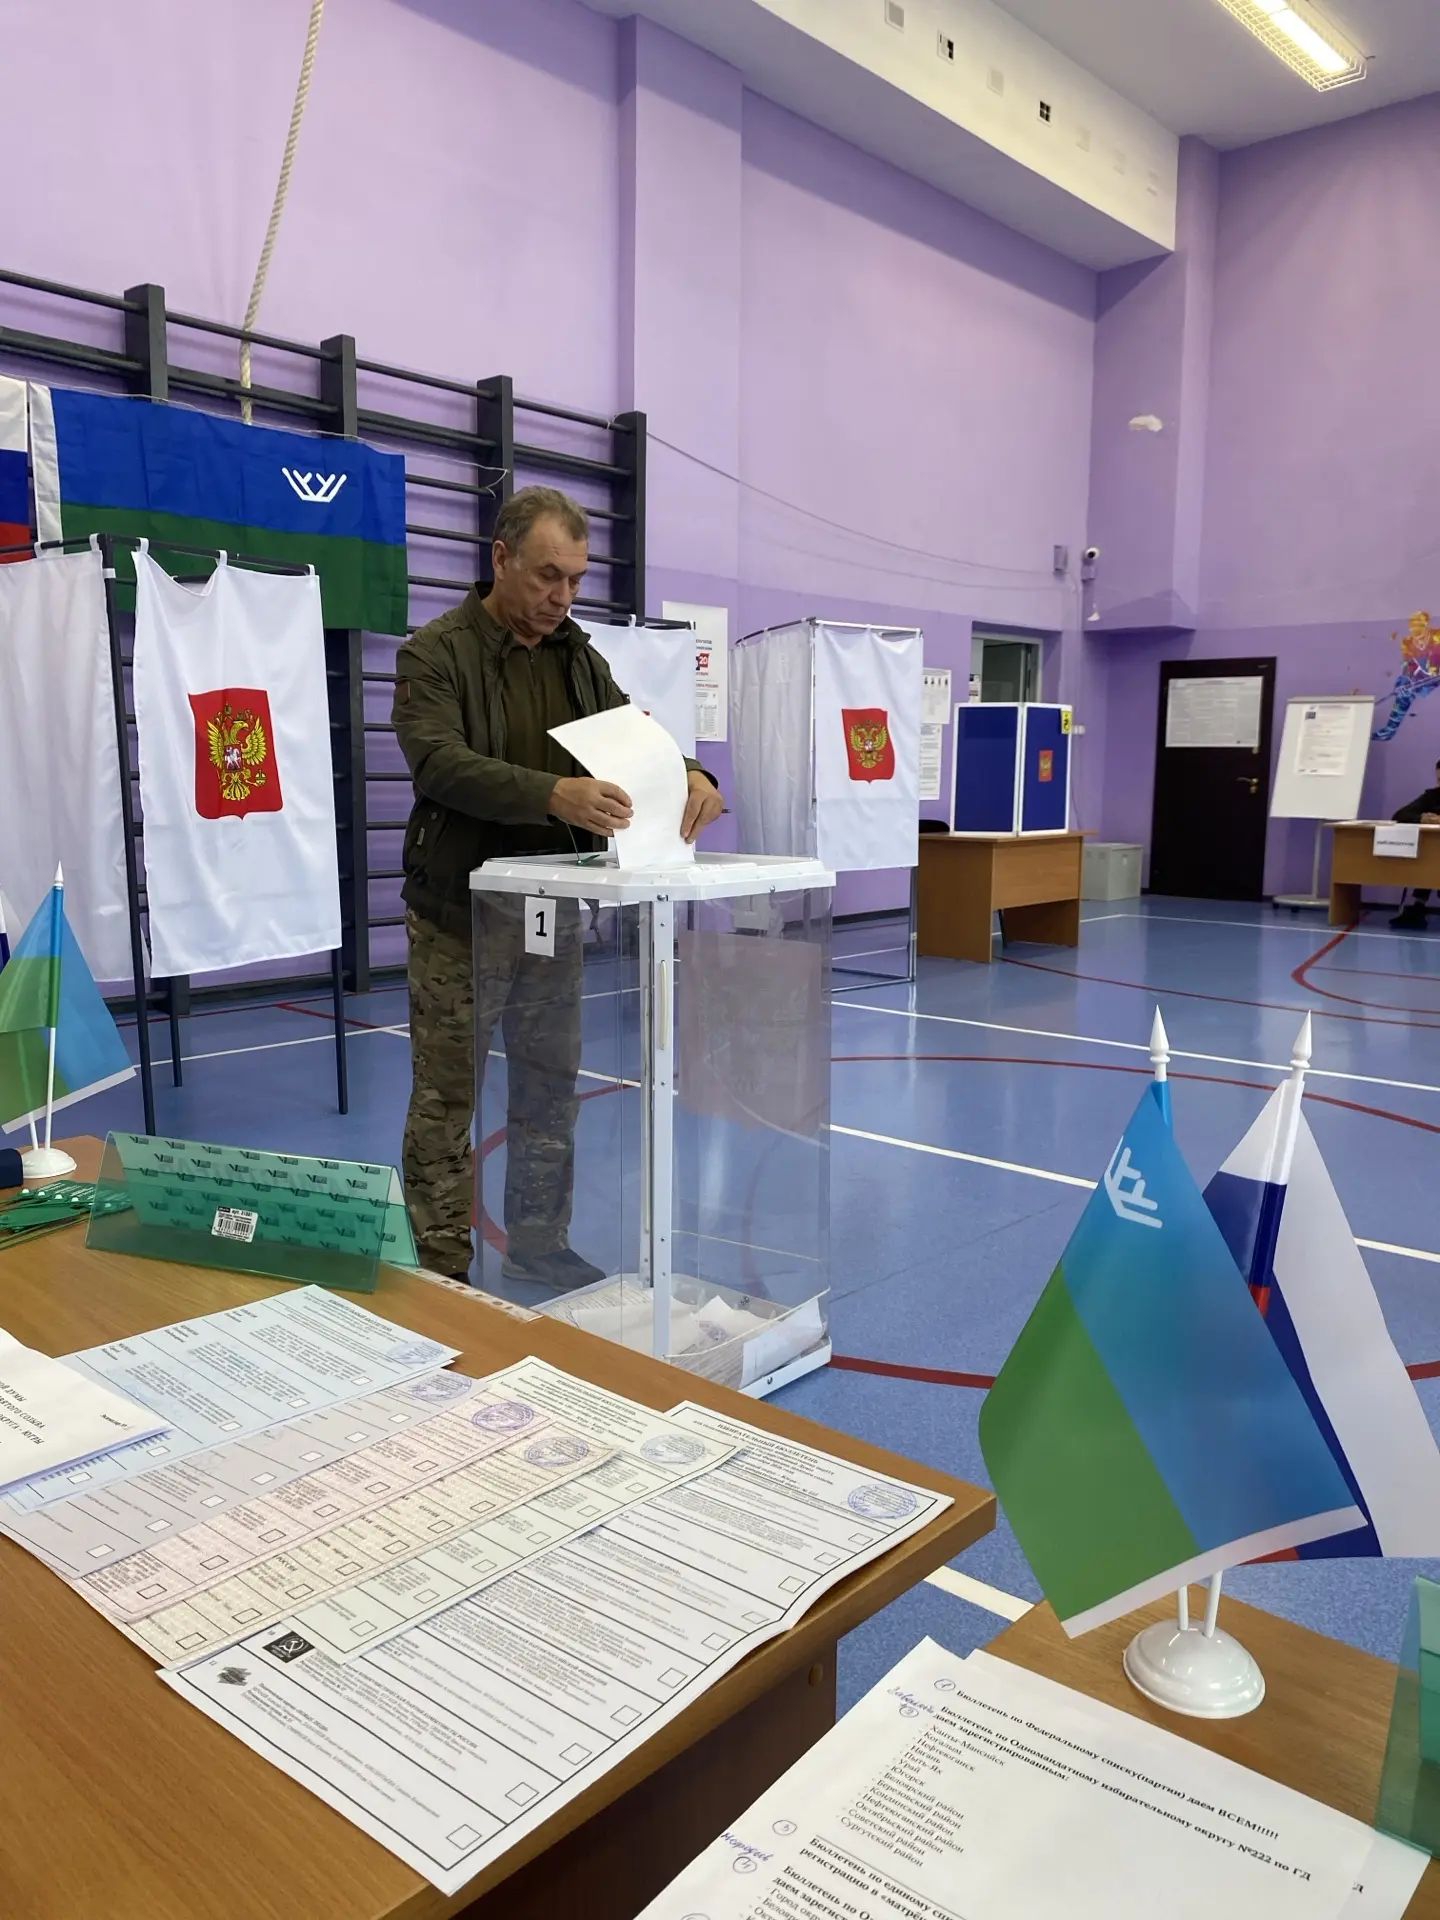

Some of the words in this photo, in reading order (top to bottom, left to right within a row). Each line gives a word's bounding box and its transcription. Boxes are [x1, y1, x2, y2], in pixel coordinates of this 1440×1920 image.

[535, 910, 547, 938] 1
[934, 1714, 957, 1728] даем
[904, 1752, 943, 1775] Пыть-Ях
[910, 1745, 941, 1764] Нягань
[917, 1738, 975, 1772] Нефтеюганск
[924, 1731, 962, 1756] Когалым
[930, 1725, 1006, 1766] Ханты-Мансийск
[957, 1690, 1008, 1718] Бюллетень
[1011, 1714, 1023, 1724] по
[1025, 1720, 1100, 1760] Федеральному
[1101, 1757, 1185, 1799] списку(партии)
[1187, 1796, 1215, 1812] даем
[890, 1766, 925, 1787] Югорск
[898, 1759, 920, 1774] Урай
[870, 1787, 925, 1819] Кондинский
[926, 1817, 954, 1836] район
[876, 1780, 933, 1812] Березовский
[933, 1809, 961, 1829] район
[884, 1772, 936, 1802] Белоярский
[936, 1800, 964, 1819] район
[941, 1706, 994, 1736] Бюллетень
[996, 1730, 1008, 1742] по
[1010, 1738, 1100, 1786] Одномандатному
[1101, 1782, 1192, 1828] избирательному
[1194, 1825, 1236, 1848] округу
[1238, 1844, 1272, 1864] №222
[1274, 1860, 1290, 1871] по
[1292, 1867, 1312, 1882] ГД
[841, 1816, 894, 1850] Сургутский
[894, 1848, 924, 1867] район
[848, 1809, 896, 1838] Советский
[896, 1836, 925, 1856] район
[855, 1801, 914, 1837] Октябрьский
[914, 1834, 943, 1854] район
[862, 1793, 934, 1836] Нефтеюганский
[934, 1834, 964, 1854] район
[772, 1877, 799, 1895] даем
[800, 1848, 870, 1891] регистрацию
[810, 1837, 866, 1874] Бюллетень
[868, 1872, 882, 1884] по
[884, 1882, 932, 1912] единому
[770, 1888, 799, 1910] Город
[783, 1866, 840, 1904] Бюллетень
[842, 1902, 857, 1914] по
[860, 1910, 874, 1920] О
